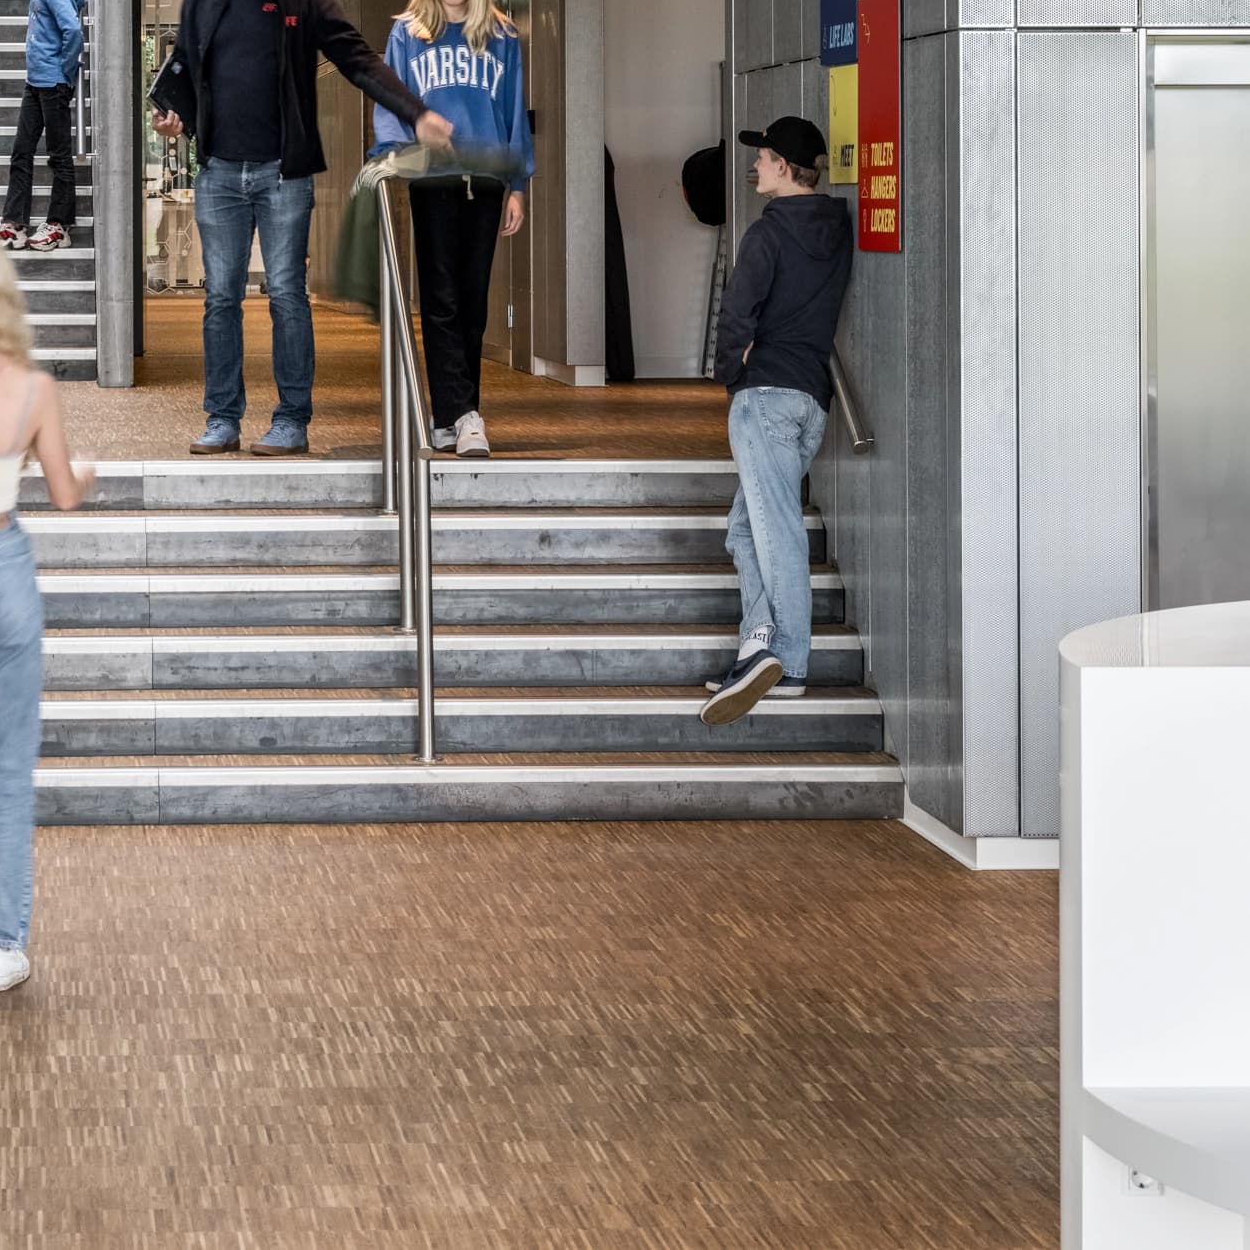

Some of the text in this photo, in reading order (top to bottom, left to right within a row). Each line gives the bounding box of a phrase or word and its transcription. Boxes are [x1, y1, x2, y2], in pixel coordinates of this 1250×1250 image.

[829, 21, 855, 49] LIFE LABS
[409, 44, 505, 101] VARSITY
[840, 143, 855, 167] MEET
[870, 141, 894, 167] TOILETS
[870, 174, 897, 200] HANGERS
[870, 207, 896, 233] LOCKERS
